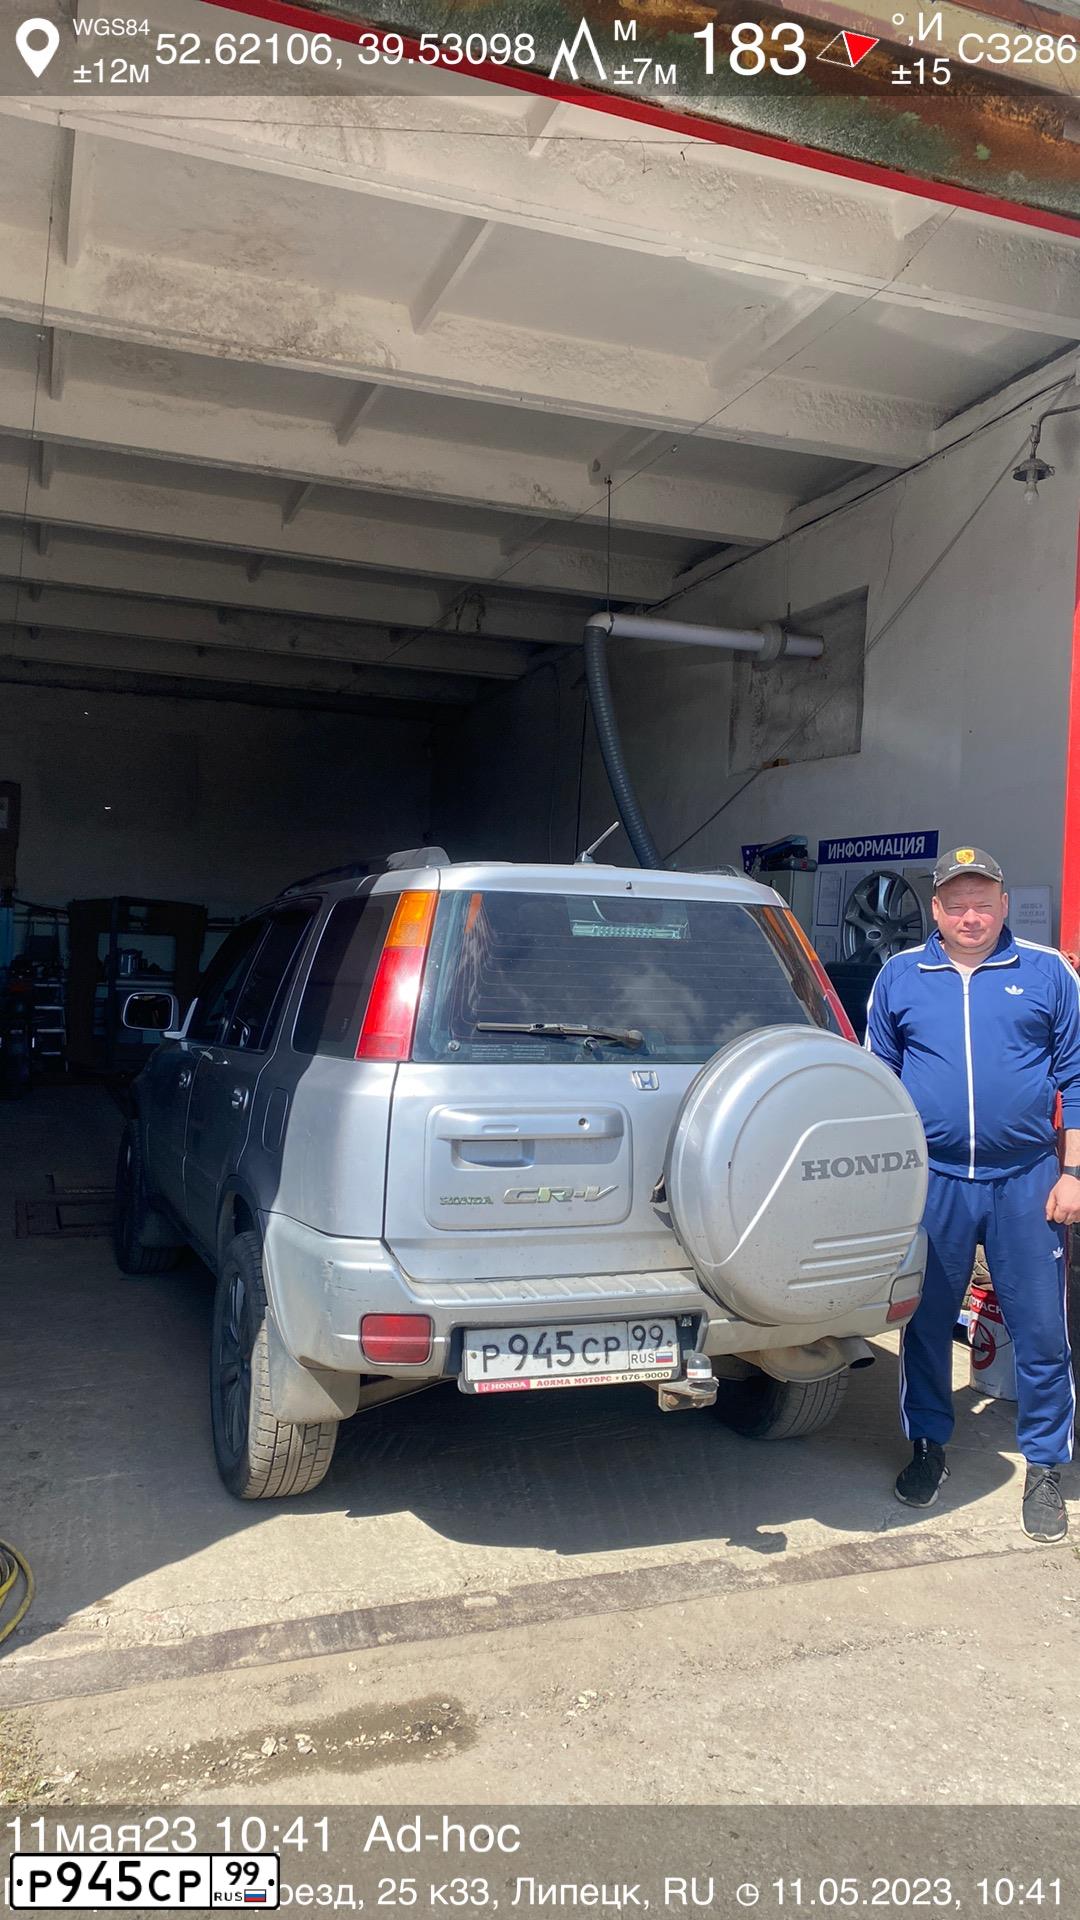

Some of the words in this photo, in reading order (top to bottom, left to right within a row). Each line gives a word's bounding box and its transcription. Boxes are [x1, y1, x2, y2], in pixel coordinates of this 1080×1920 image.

[827, 835, 926, 860] ИНФОРМАЦИЯ
[801, 1149, 924, 1181] HONDA
[503, 1185, 619, 1204] CR-V
[481, 1330, 622, 1373] Р945СР
[631, 1324, 664, 1351] 99
[631, 1352, 655, 1365] RUS
[491, 1381, 528, 1391] HONDA
[621, 1371, 670, 1382] 676-9000
